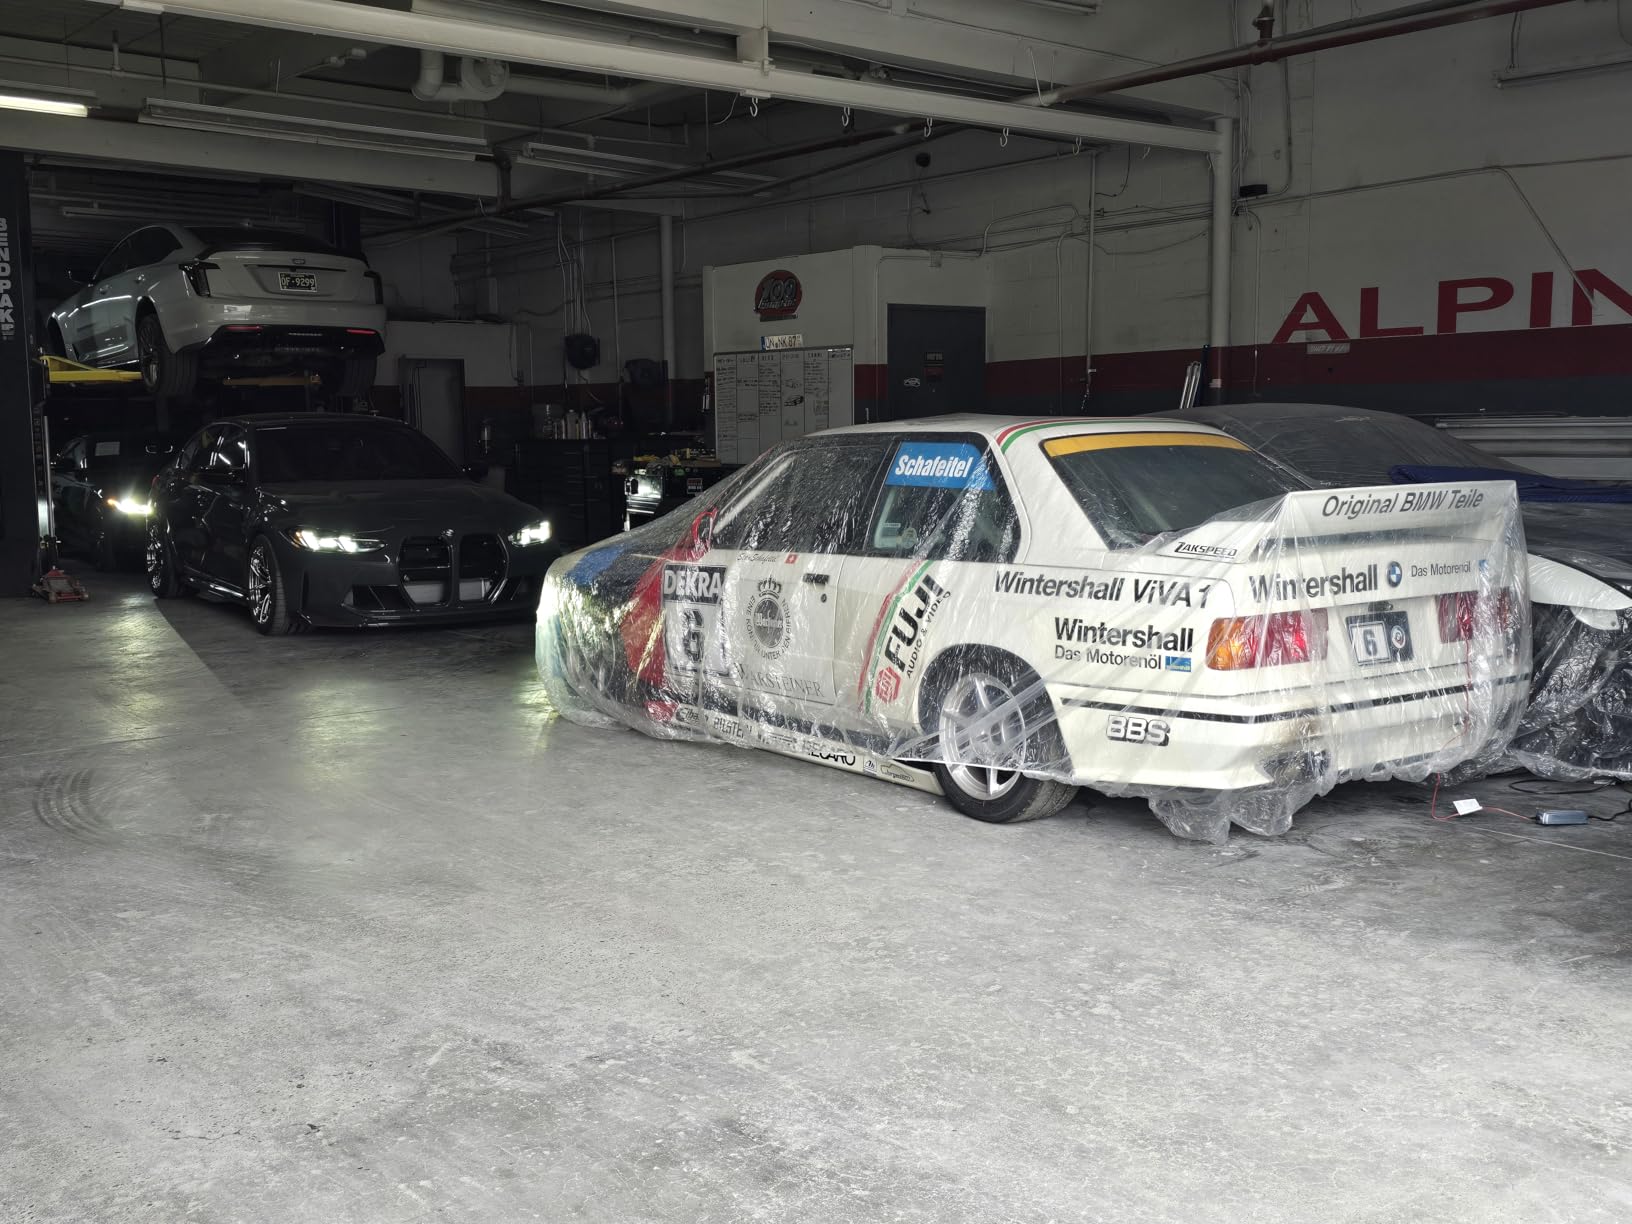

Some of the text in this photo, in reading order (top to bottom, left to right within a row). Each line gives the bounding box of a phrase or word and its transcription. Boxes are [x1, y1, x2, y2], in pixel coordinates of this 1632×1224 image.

[895, 454, 974, 478] Schafeitel
[1321, 488, 1484, 519] Original BMW Teile
[1174, 541, 1238, 557] ZAKSPEED
[664, 569, 724, 599] DEKRA
[1410, 564, 1428, 578] Das
[994, 569, 1126, 602] Wintershall
[1198, 584, 1211, 609] 1
[683, 608, 704, 664] 6
[884, 574, 944, 673] FUJI
[906, 638, 923, 678] AUDIO
[926, 590, 951, 624] VIDEO
[1054, 616, 1194, 652] Wintershall
[1054, 644, 1162, 670] Das Motorenöl
[1363, 628, 1378, 656] 6
[1106, 714, 1171, 746] BBS
